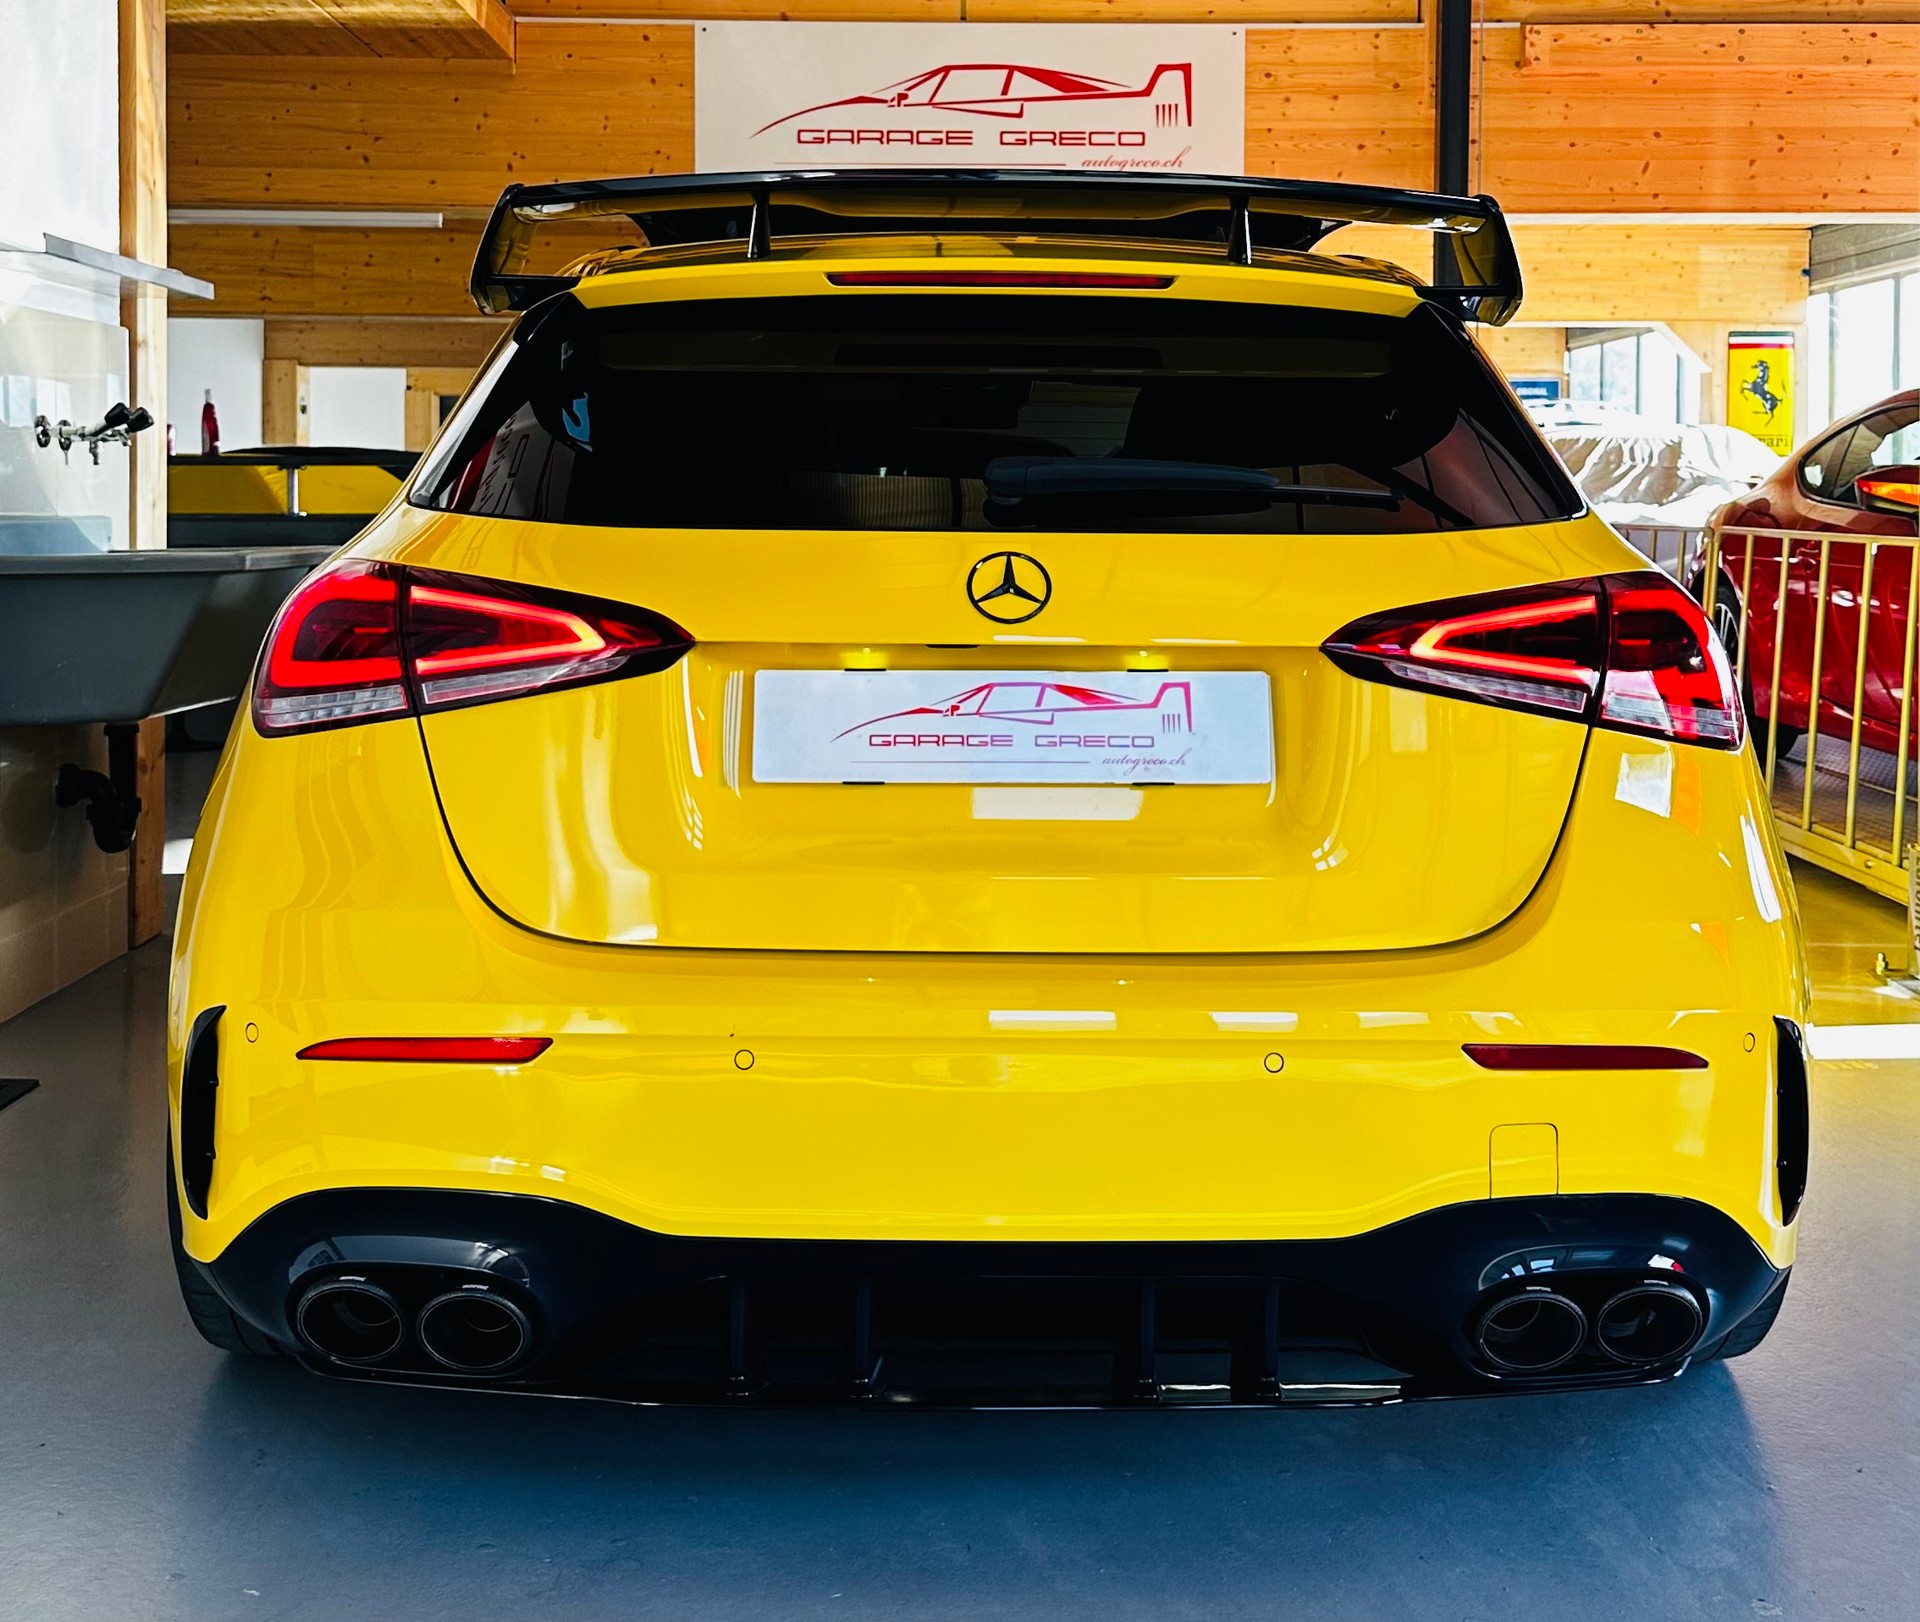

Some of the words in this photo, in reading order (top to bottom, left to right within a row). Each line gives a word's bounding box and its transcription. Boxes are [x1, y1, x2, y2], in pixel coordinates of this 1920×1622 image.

[797, 129, 974, 146] GARAGE
[999, 130, 1146, 147] GRECO
[1080, 145, 1192, 172] autogreco.ch
[868, 733, 1014, 747] GARAGE
[1034, 735, 1155, 748] GRECO
[1102, 747, 1192, 776] autogreco.ch
